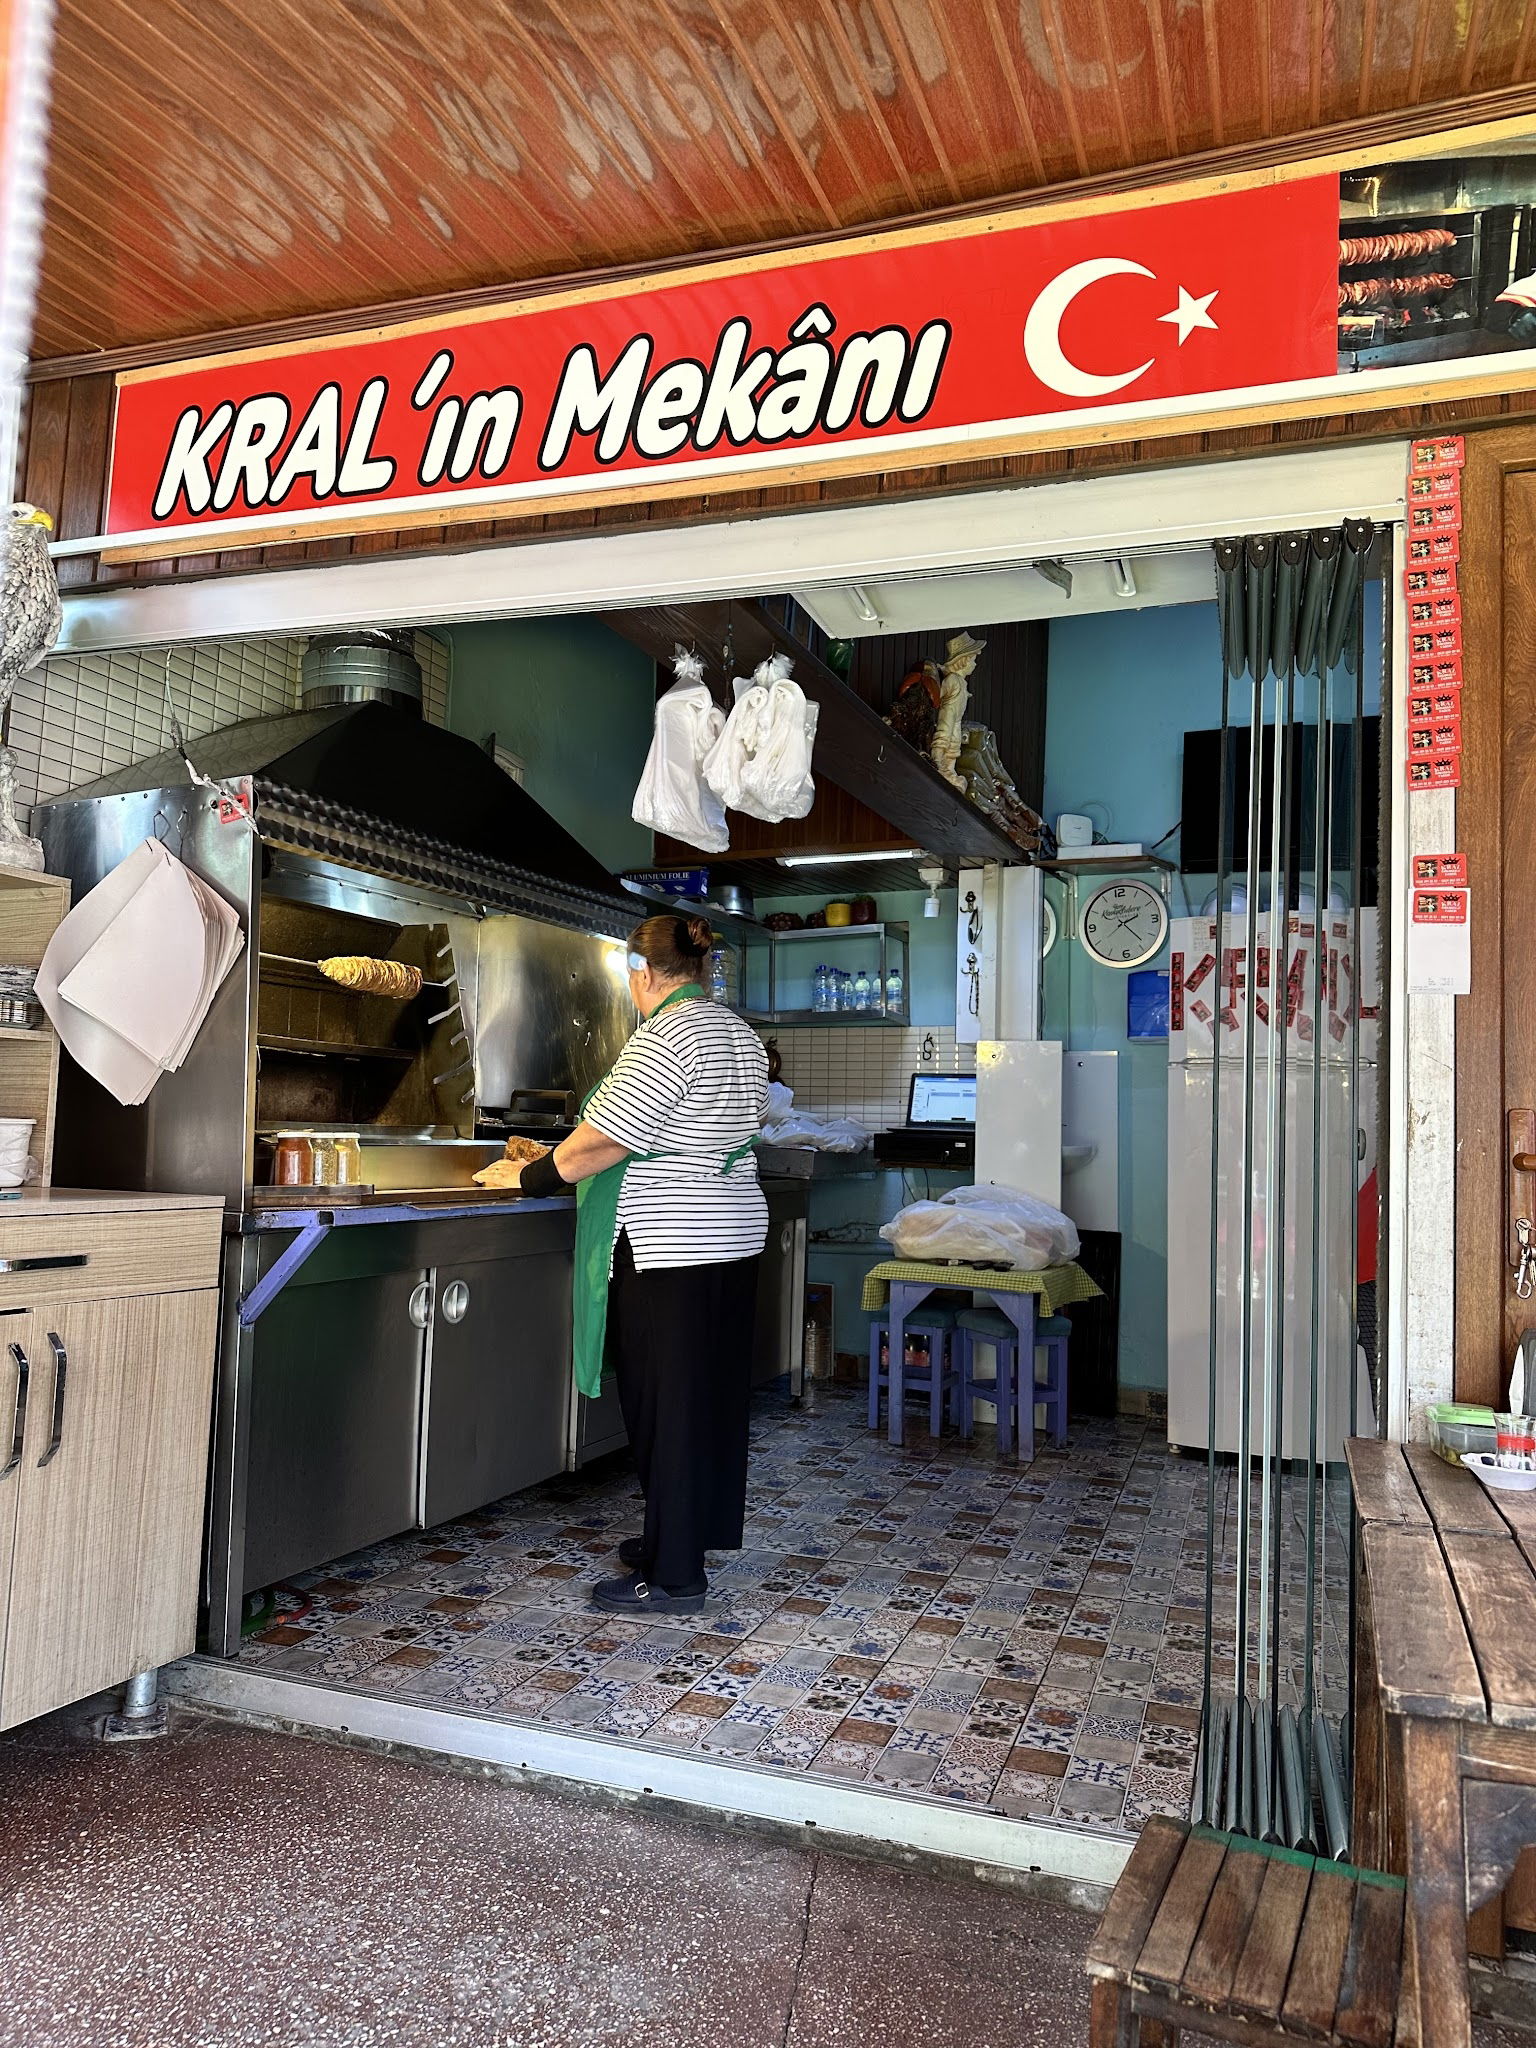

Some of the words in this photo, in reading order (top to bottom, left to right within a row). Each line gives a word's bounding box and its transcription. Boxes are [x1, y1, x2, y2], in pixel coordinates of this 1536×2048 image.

[538, 301, 952, 471] Mekânı
[668, 871, 690, 880] FOLIE
[1114, 888, 1126, 898] 12
[1151, 914, 1159, 923] 3
[1088, 924, 1096, 933] 9
[1122, 949, 1130, 958] 6
